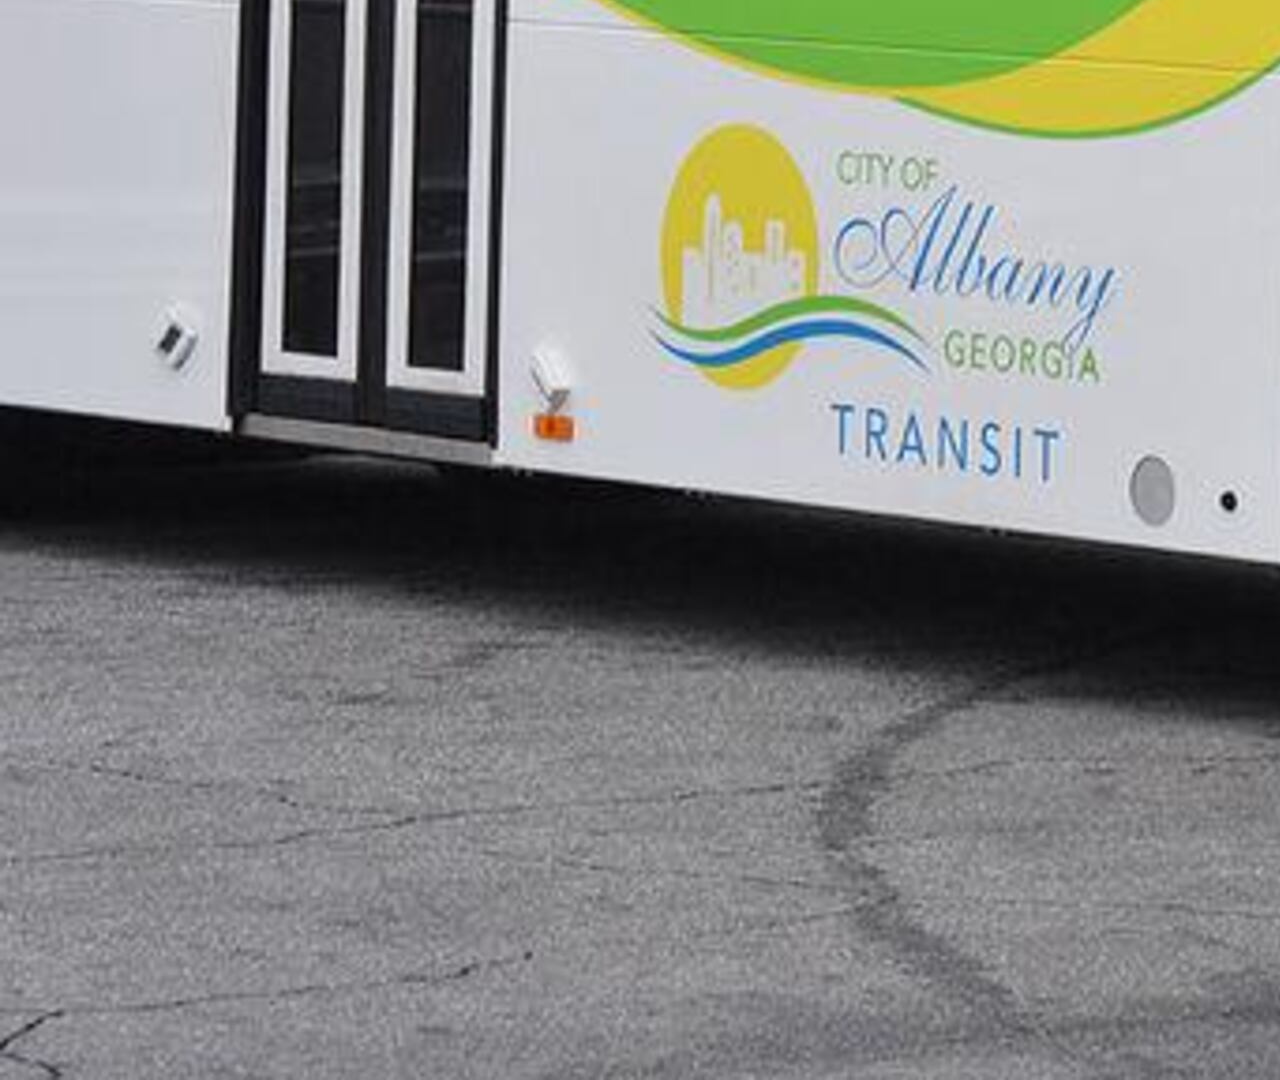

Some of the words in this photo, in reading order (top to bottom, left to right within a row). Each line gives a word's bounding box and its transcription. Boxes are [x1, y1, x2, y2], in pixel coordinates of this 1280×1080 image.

[836, 151, 894, 186] CITY
[900, 157, 940, 191] OF
[834, 184, 1115, 350] Albany
[944, 329, 1100, 383] GEORGIA
[830, 403, 1060, 482] TRANSIT
